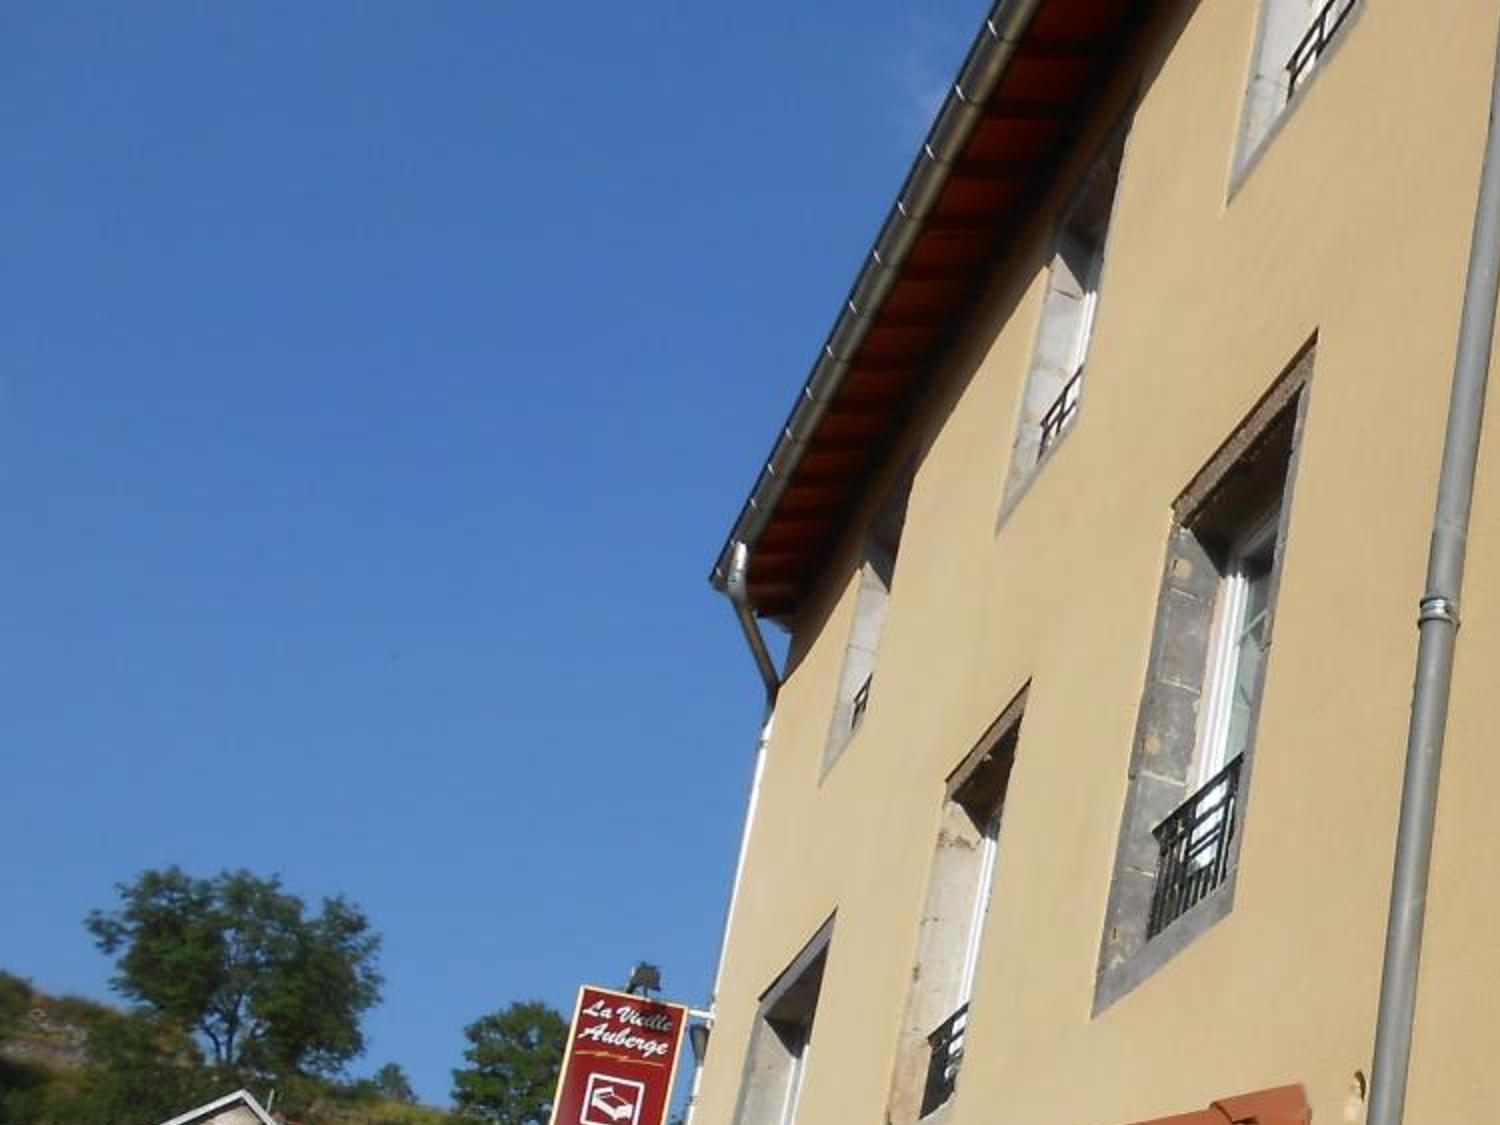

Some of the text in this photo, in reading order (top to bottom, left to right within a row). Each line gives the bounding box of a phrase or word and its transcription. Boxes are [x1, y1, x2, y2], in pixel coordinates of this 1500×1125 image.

[582, 999, 673, 1032] La Vieille
[577, 1022, 669, 1058] Auberge
